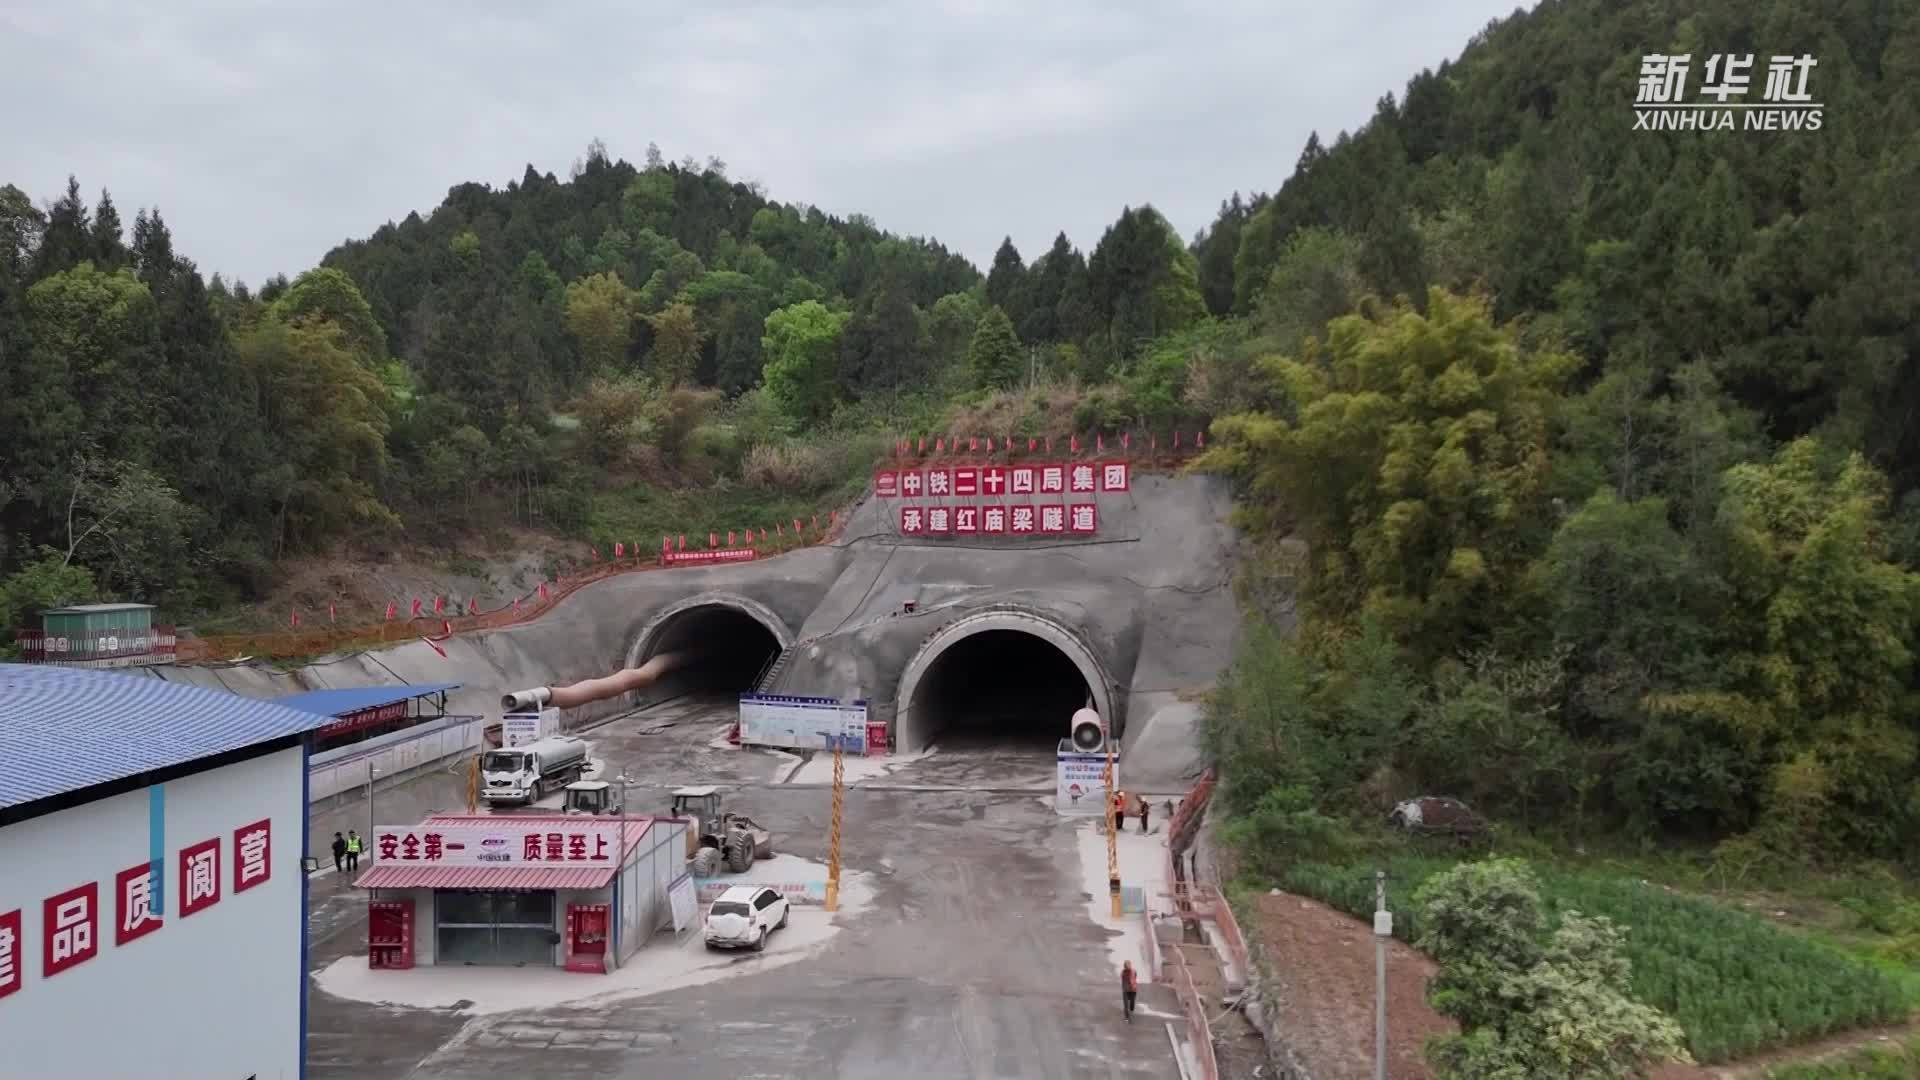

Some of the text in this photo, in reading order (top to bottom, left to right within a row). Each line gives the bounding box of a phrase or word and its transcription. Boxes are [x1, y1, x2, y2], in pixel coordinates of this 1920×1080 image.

[903, 465, 1126, 495] 中铁二十四局集团
[903, 507, 1095, 533] 承建红庙梁隧道
[379, 833, 609, 862] 安全第一 质量至上
